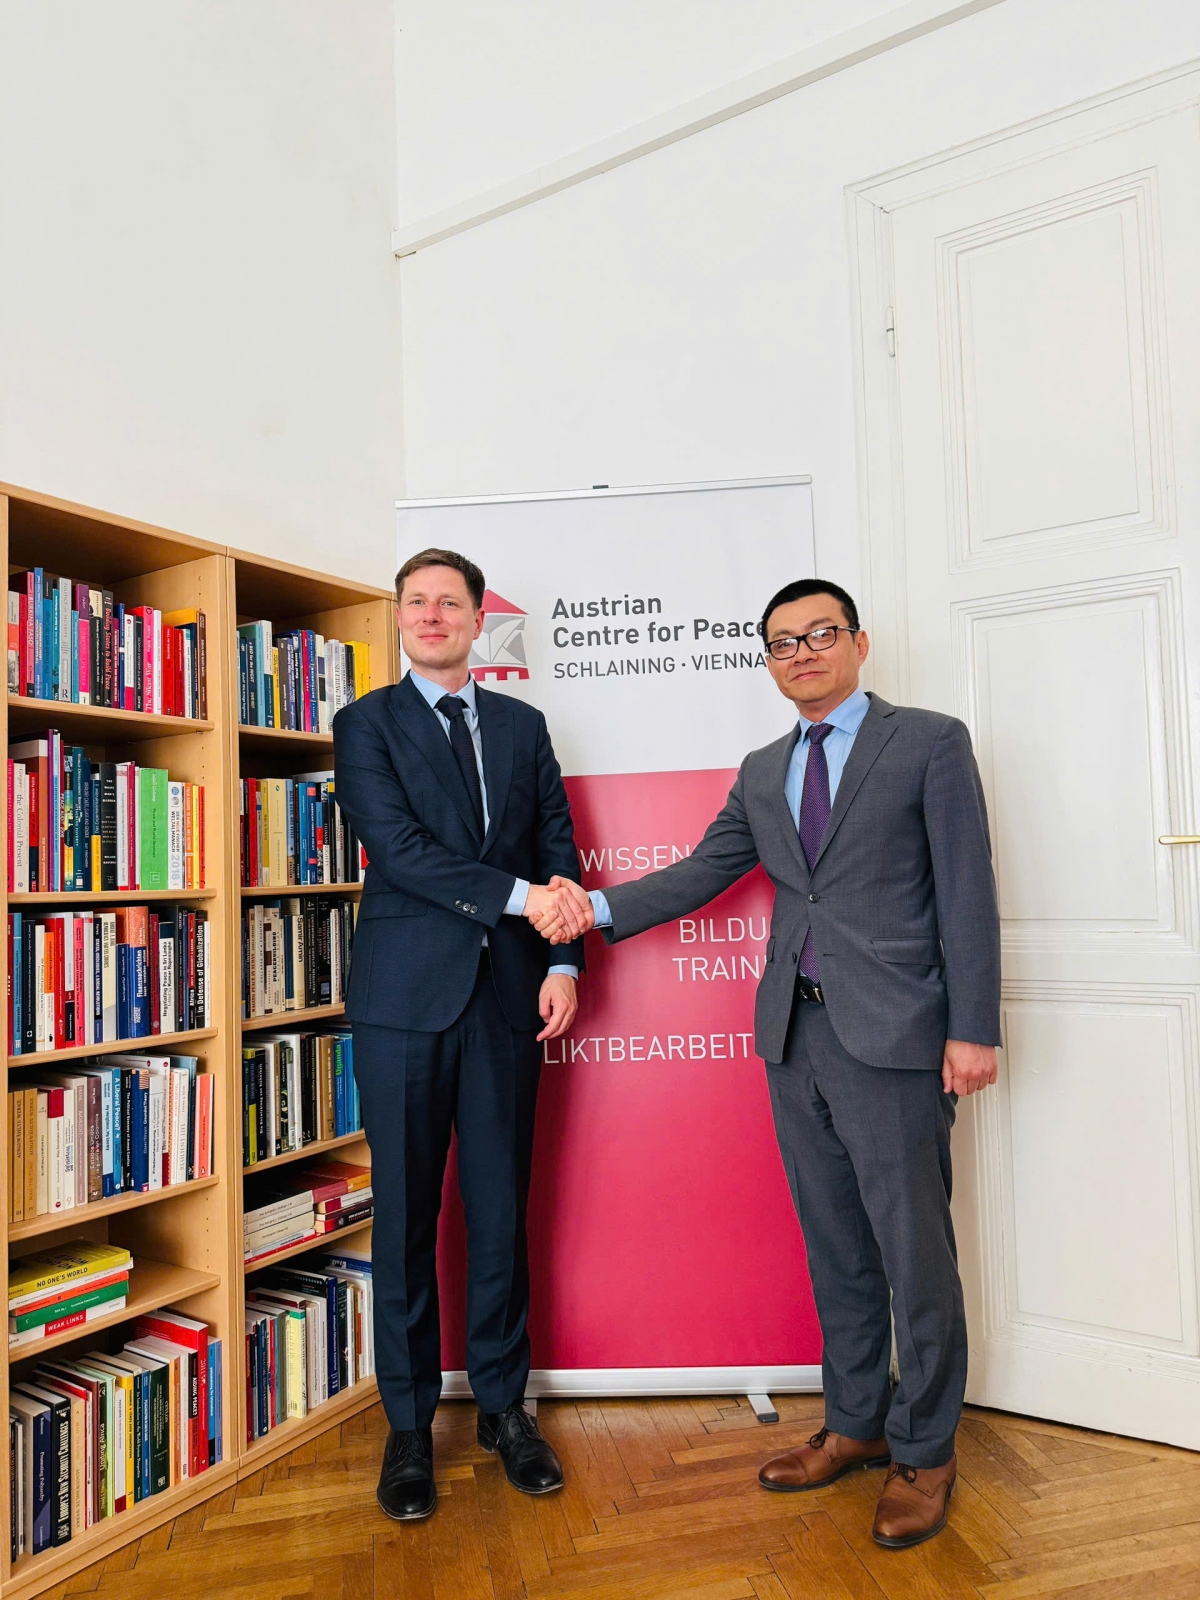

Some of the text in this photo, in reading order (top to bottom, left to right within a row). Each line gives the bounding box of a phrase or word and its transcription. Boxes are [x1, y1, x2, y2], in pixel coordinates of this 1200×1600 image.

[104, 608, 112, 632] Building
[551, 593, 662, 620] Austrian
[104, 633, 112, 650] States
[553, 623, 640, 648] Centre
[647, 621, 685, 644] for
[104, 658, 112, 673] Build
[554, 652, 767, 680] SCHLAINING VIENNA
[104, 674, 112, 690] Peace
[171, 855, 180, 880] 2018
[579, 844, 691, 873] WISSEN
[679, 916, 767, 944] BILDU
[197, 925, 205, 968] Globalization
[197, 969, 205, 979] of
[672, 955, 767, 982] TRAIN
[197, 980, 205, 1005] Defense
[335, 1044, 343, 1076] Uganda
[543, 1033, 753, 1064] LIKTBEARBEIT
[94, 1140, 101, 1149] en
[37, 1267, 88, 1288] NO ONE'S WORLD
[48, 1314, 84, 1332] WEAK LINKS
[98, 1444, 106, 1471] Uniting
[58, 1420, 69, 1523] EUROPE'S NEW SECURITY CHALLENGES
